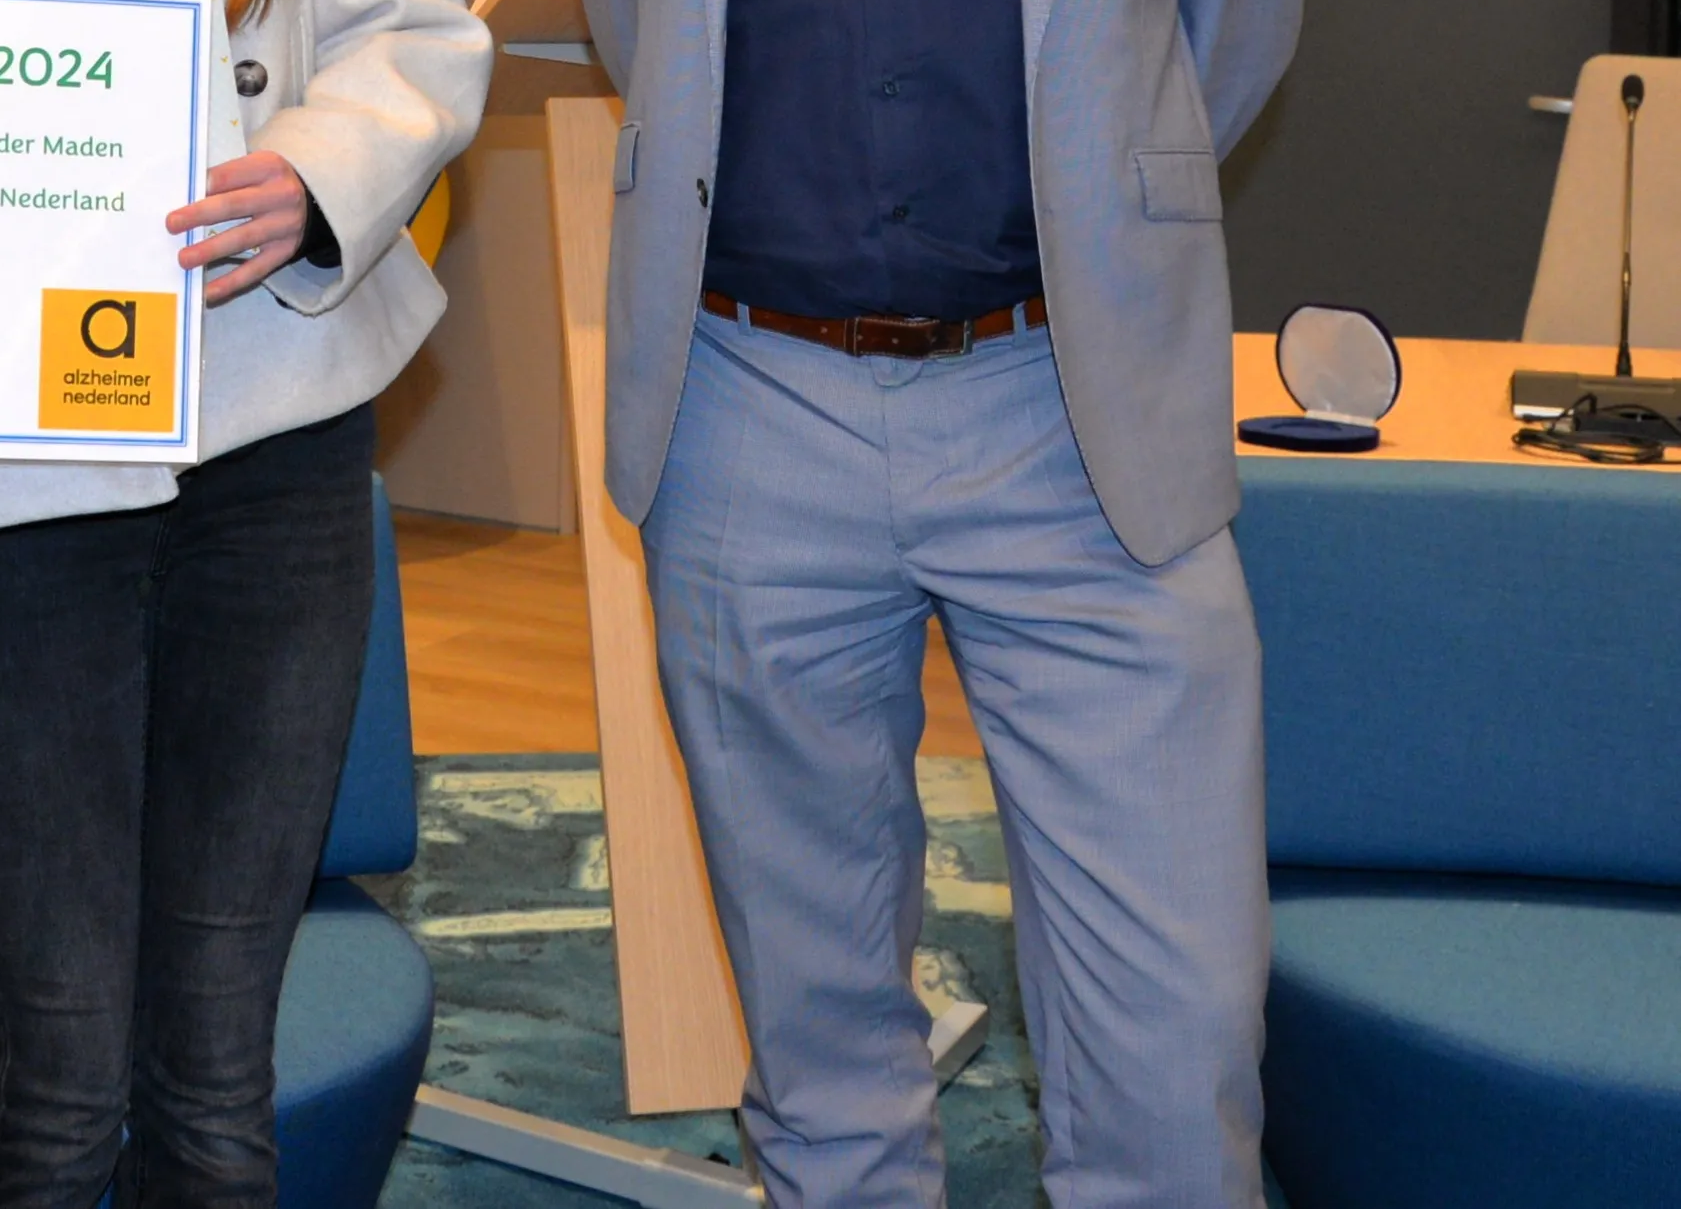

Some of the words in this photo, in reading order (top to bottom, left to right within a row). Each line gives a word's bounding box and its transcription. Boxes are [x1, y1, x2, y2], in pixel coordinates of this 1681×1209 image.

[43, 135, 124, 159] Maden
[0, 187, 125, 212] Nederland
[63, 369, 151, 388] alzheimer
[63, 389, 151, 407] nederland
